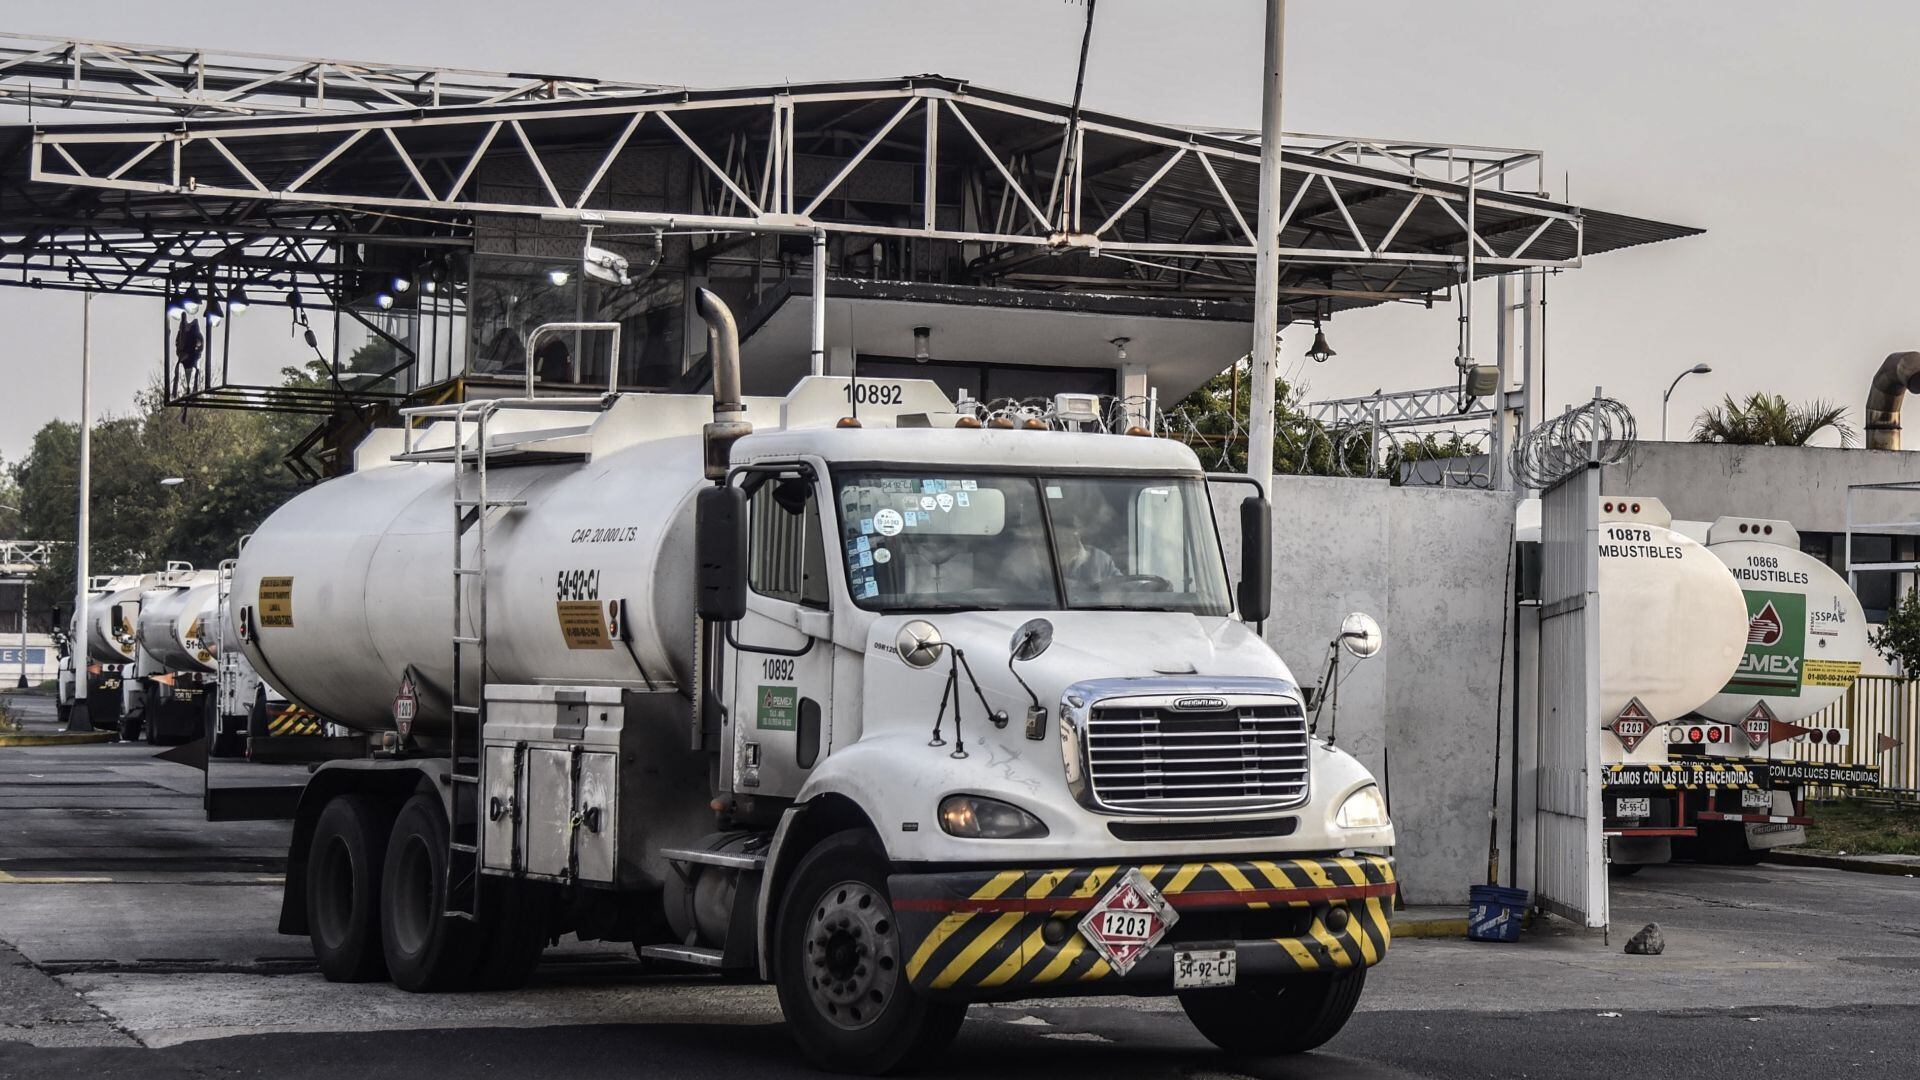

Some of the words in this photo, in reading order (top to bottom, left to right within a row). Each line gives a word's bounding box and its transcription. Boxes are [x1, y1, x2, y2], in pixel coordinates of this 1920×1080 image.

[843, 383, 903, 405] 10892
[571, 528, 592, 543] CAP.
[1607, 528, 1651, 542] 10878
[1746, 556, 1778, 568] 10868
[1728, 568, 1809, 584] MBUSTIBLES
[557, 569, 600, 601] 54-92-CJ
[1815, 611, 1839, 623] SSPA
[762, 658, 795, 681] 10892
[773, 696, 793, 706] PEMEX
[398, 701, 412, 717] 1203
[402, 722, 407, 734] 3
[1620, 722, 1642, 733] 1203
[1748, 720, 1768, 732] 1203
[1627, 736, 1635, 745] 3
[1754, 734, 1761, 742] 3
[1643, 770, 1660, 785] CON
[1662, 771, 1677, 784] LAS
[1705, 771, 1754, 785] ENCENDIDAS
[1769, 765, 1786, 777] CON
[1787, 766, 1803, 778] LAS
[1804, 767, 1829, 780] LUCES
[1830, 769, 1879, 783] ENCENDIDAS
[1106, 915, 1146, 937] 1203
[1117, 944, 1130, 959] 3
[1179, 961, 1232, 979] 54-92-CJ
